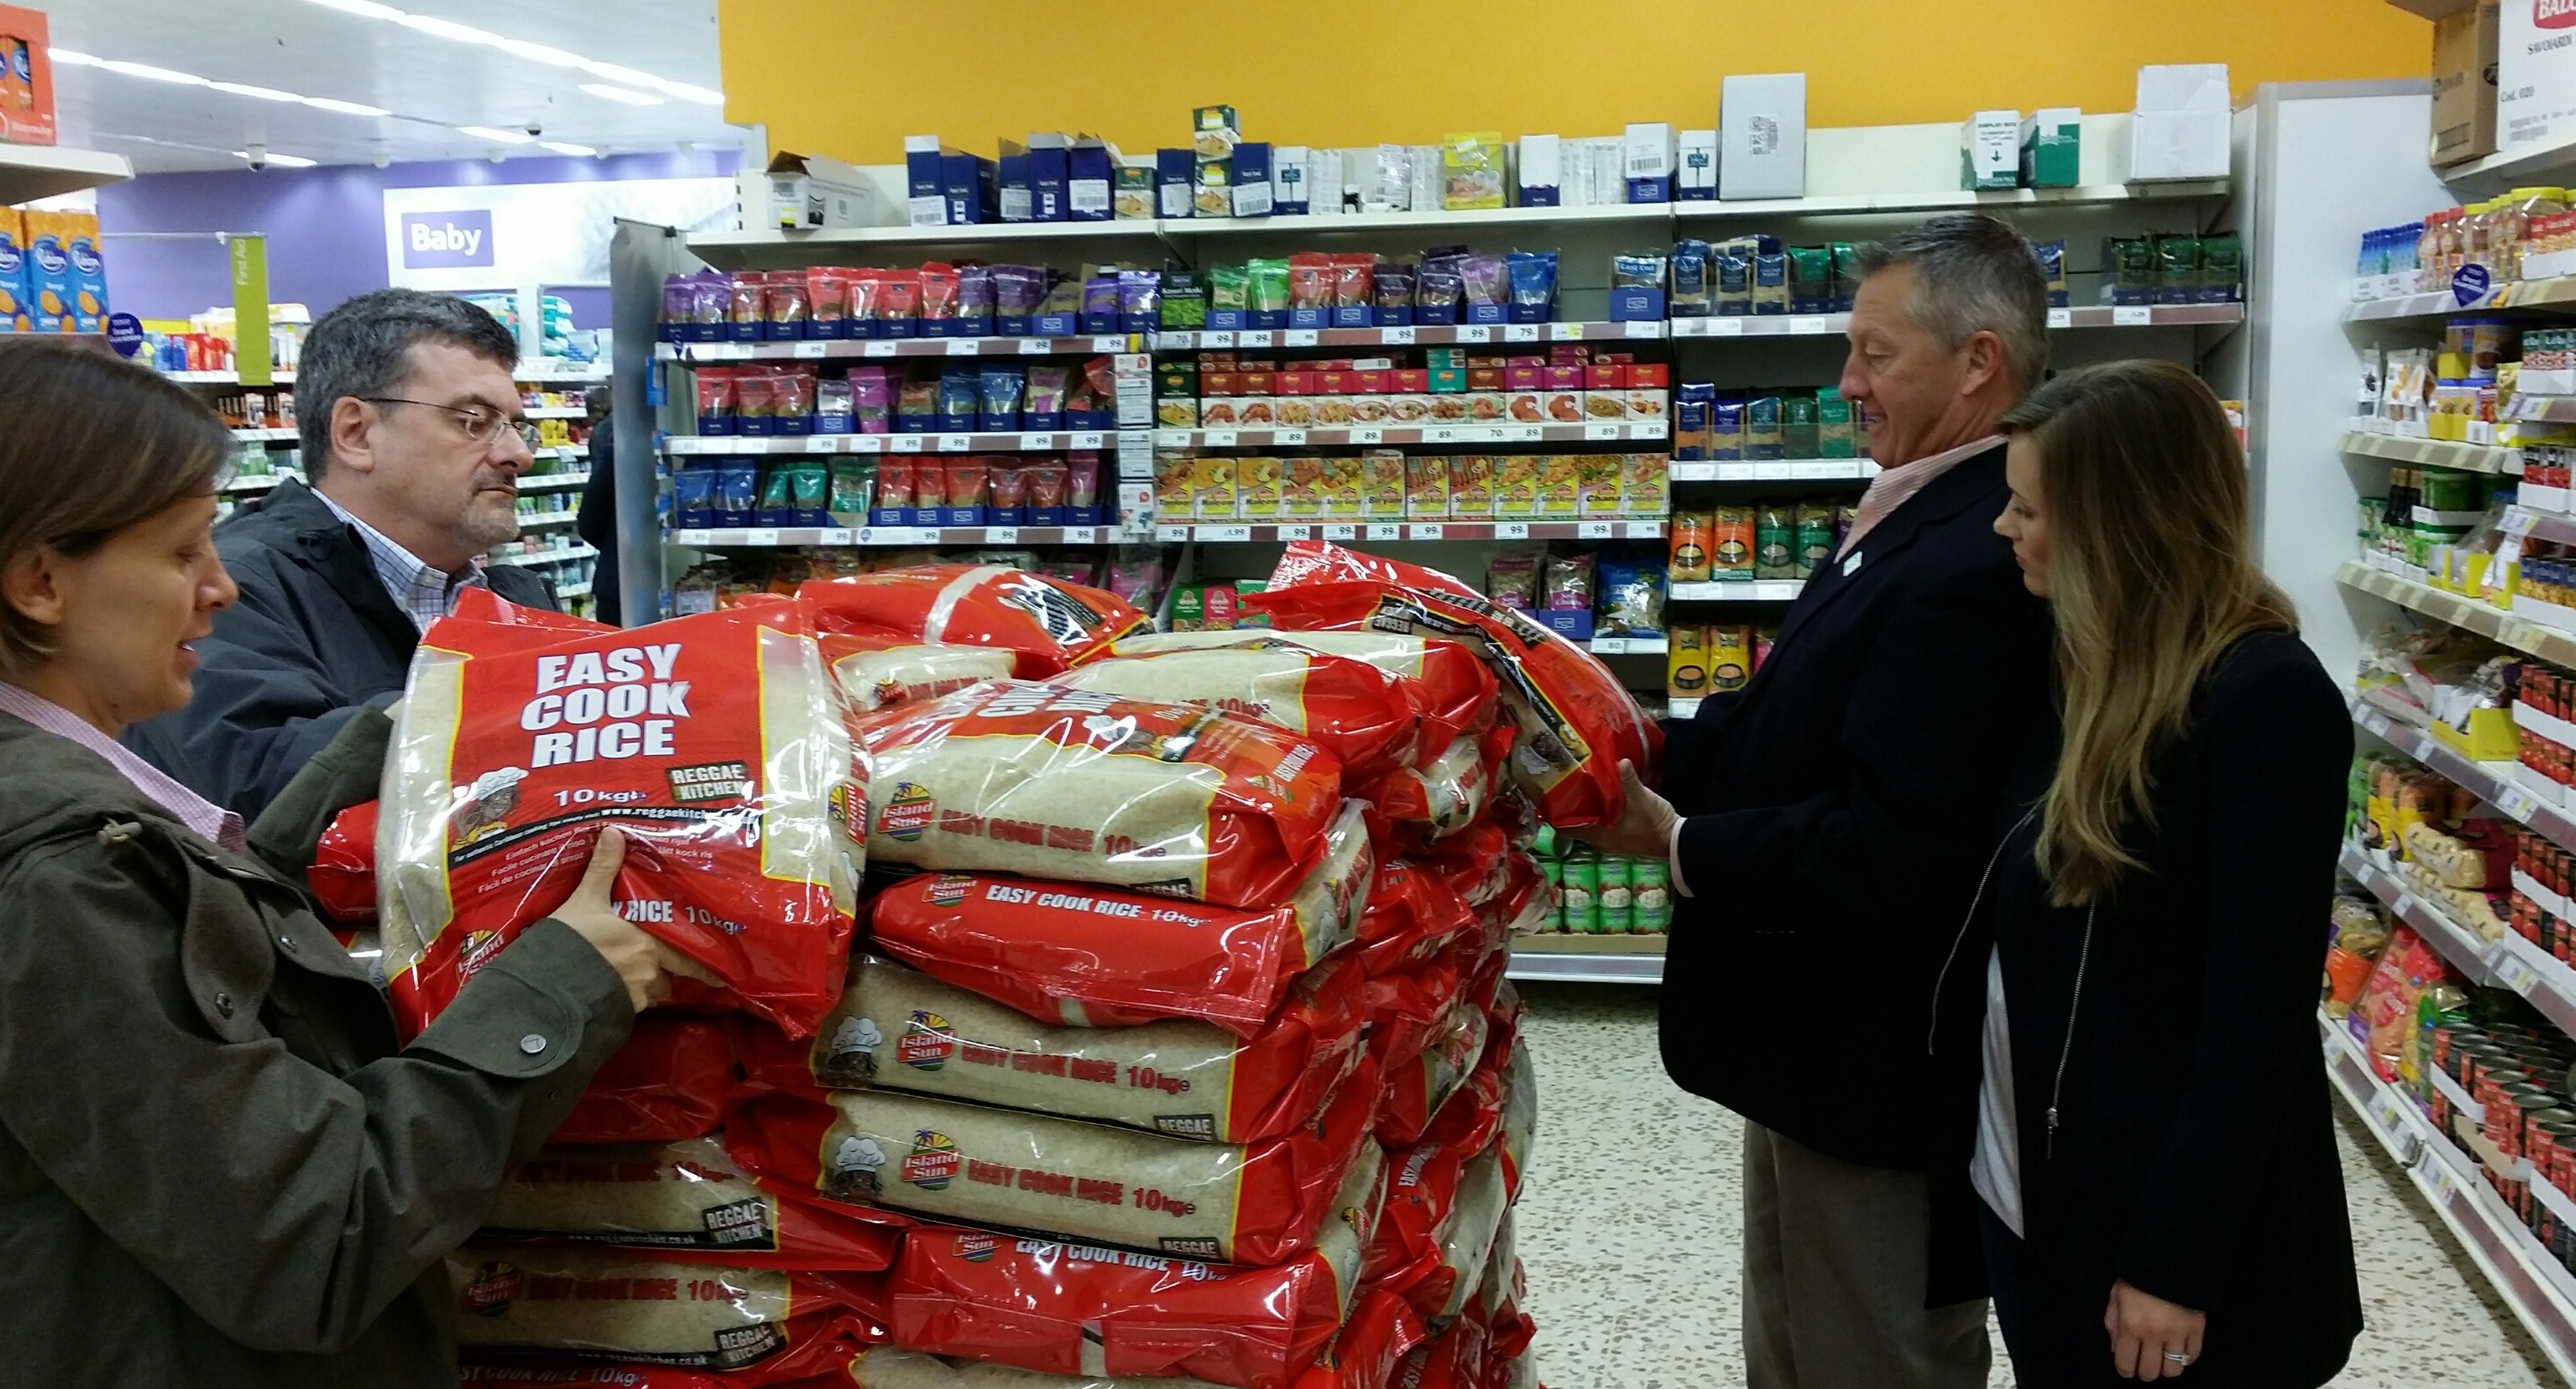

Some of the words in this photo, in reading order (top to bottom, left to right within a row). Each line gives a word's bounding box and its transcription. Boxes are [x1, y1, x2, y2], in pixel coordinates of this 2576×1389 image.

[235, 238, 246, 258] Aid
[411, 223, 482, 257] Baby
[236, 260, 248, 286] First
[1587, 494, 1622, 503] Chana
[537, 642, 683, 694] EASY
[520, 681, 692, 731] COOK
[530, 719, 676, 769] RICE
[673, 765, 744, 783] REGGAE
[680, 782, 746, 800] KITCHEN
[883, 802, 933, 818] Island
[888, 816, 922, 829] Sun
[940, 809, 987, 837] EASY
[989, 818, 1045, 846] COOK
[1047, 825, 1094, 852] RICE
[986, 884, 1037, 905] EASY
[1037, 893, 1094, 912] COOK
[1094, 901, 1143, 918] RICE
[626, 899, 673, 923] RICE
[901, 1031, 954, 1049] Island
[908, 1045, 942, 1059] Sun
[1070, 1057, 1118, 1085] RICE
[1159, 1117, 1212, 1135] REGGAE
[905, 1152, 958, 1169] Island
[913, 1165, 948, 1179] Sun
[967, 1159, 1015, 1187] EASY
[1018, 1168, 1075, 1197] COOK
[1077, 1177, 1124, 1205] RICE
[706, 1202, 762, 1229] REGGAE
[963, 1240, 994, 1253] Sun
[1164, 1239, 1216, 1256] REGGAE
